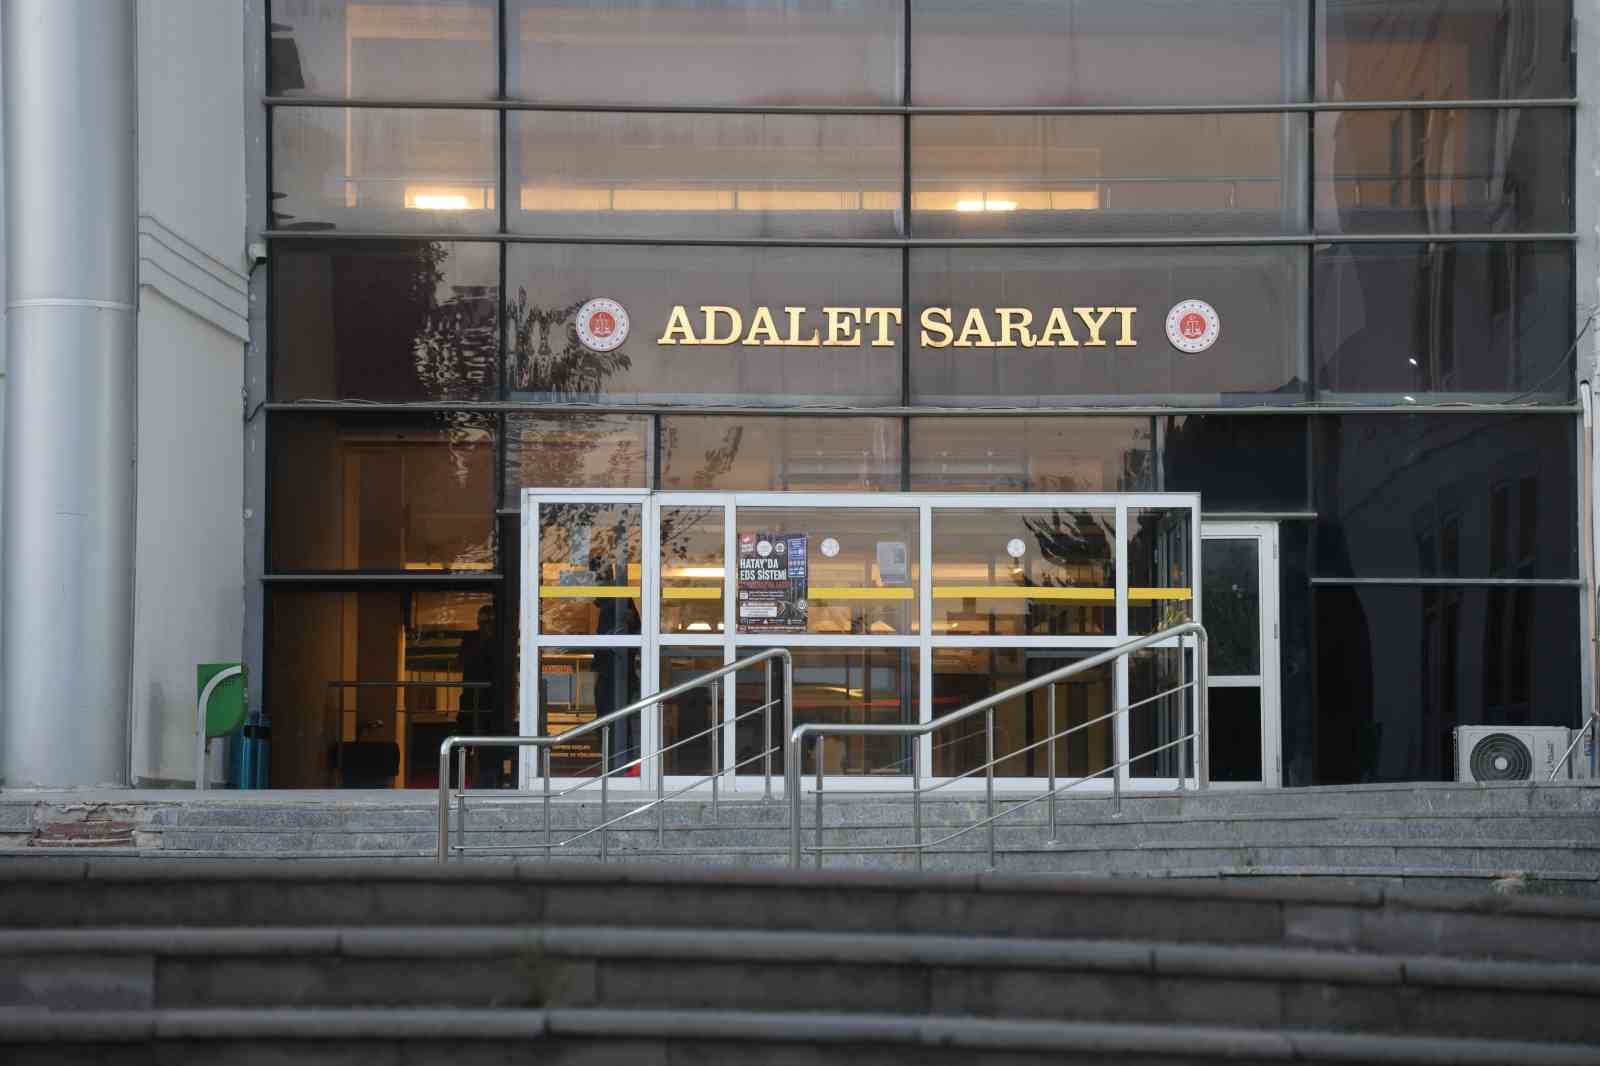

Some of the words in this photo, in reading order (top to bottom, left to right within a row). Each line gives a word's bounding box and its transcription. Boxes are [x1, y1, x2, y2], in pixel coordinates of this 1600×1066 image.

[657, 305, 902, 346] ADALET
[920, 306, 1137, 347] SARAYI
[740, 558, 779, 569] HATAY'DA
[740, 570, 756, 581] EDS
